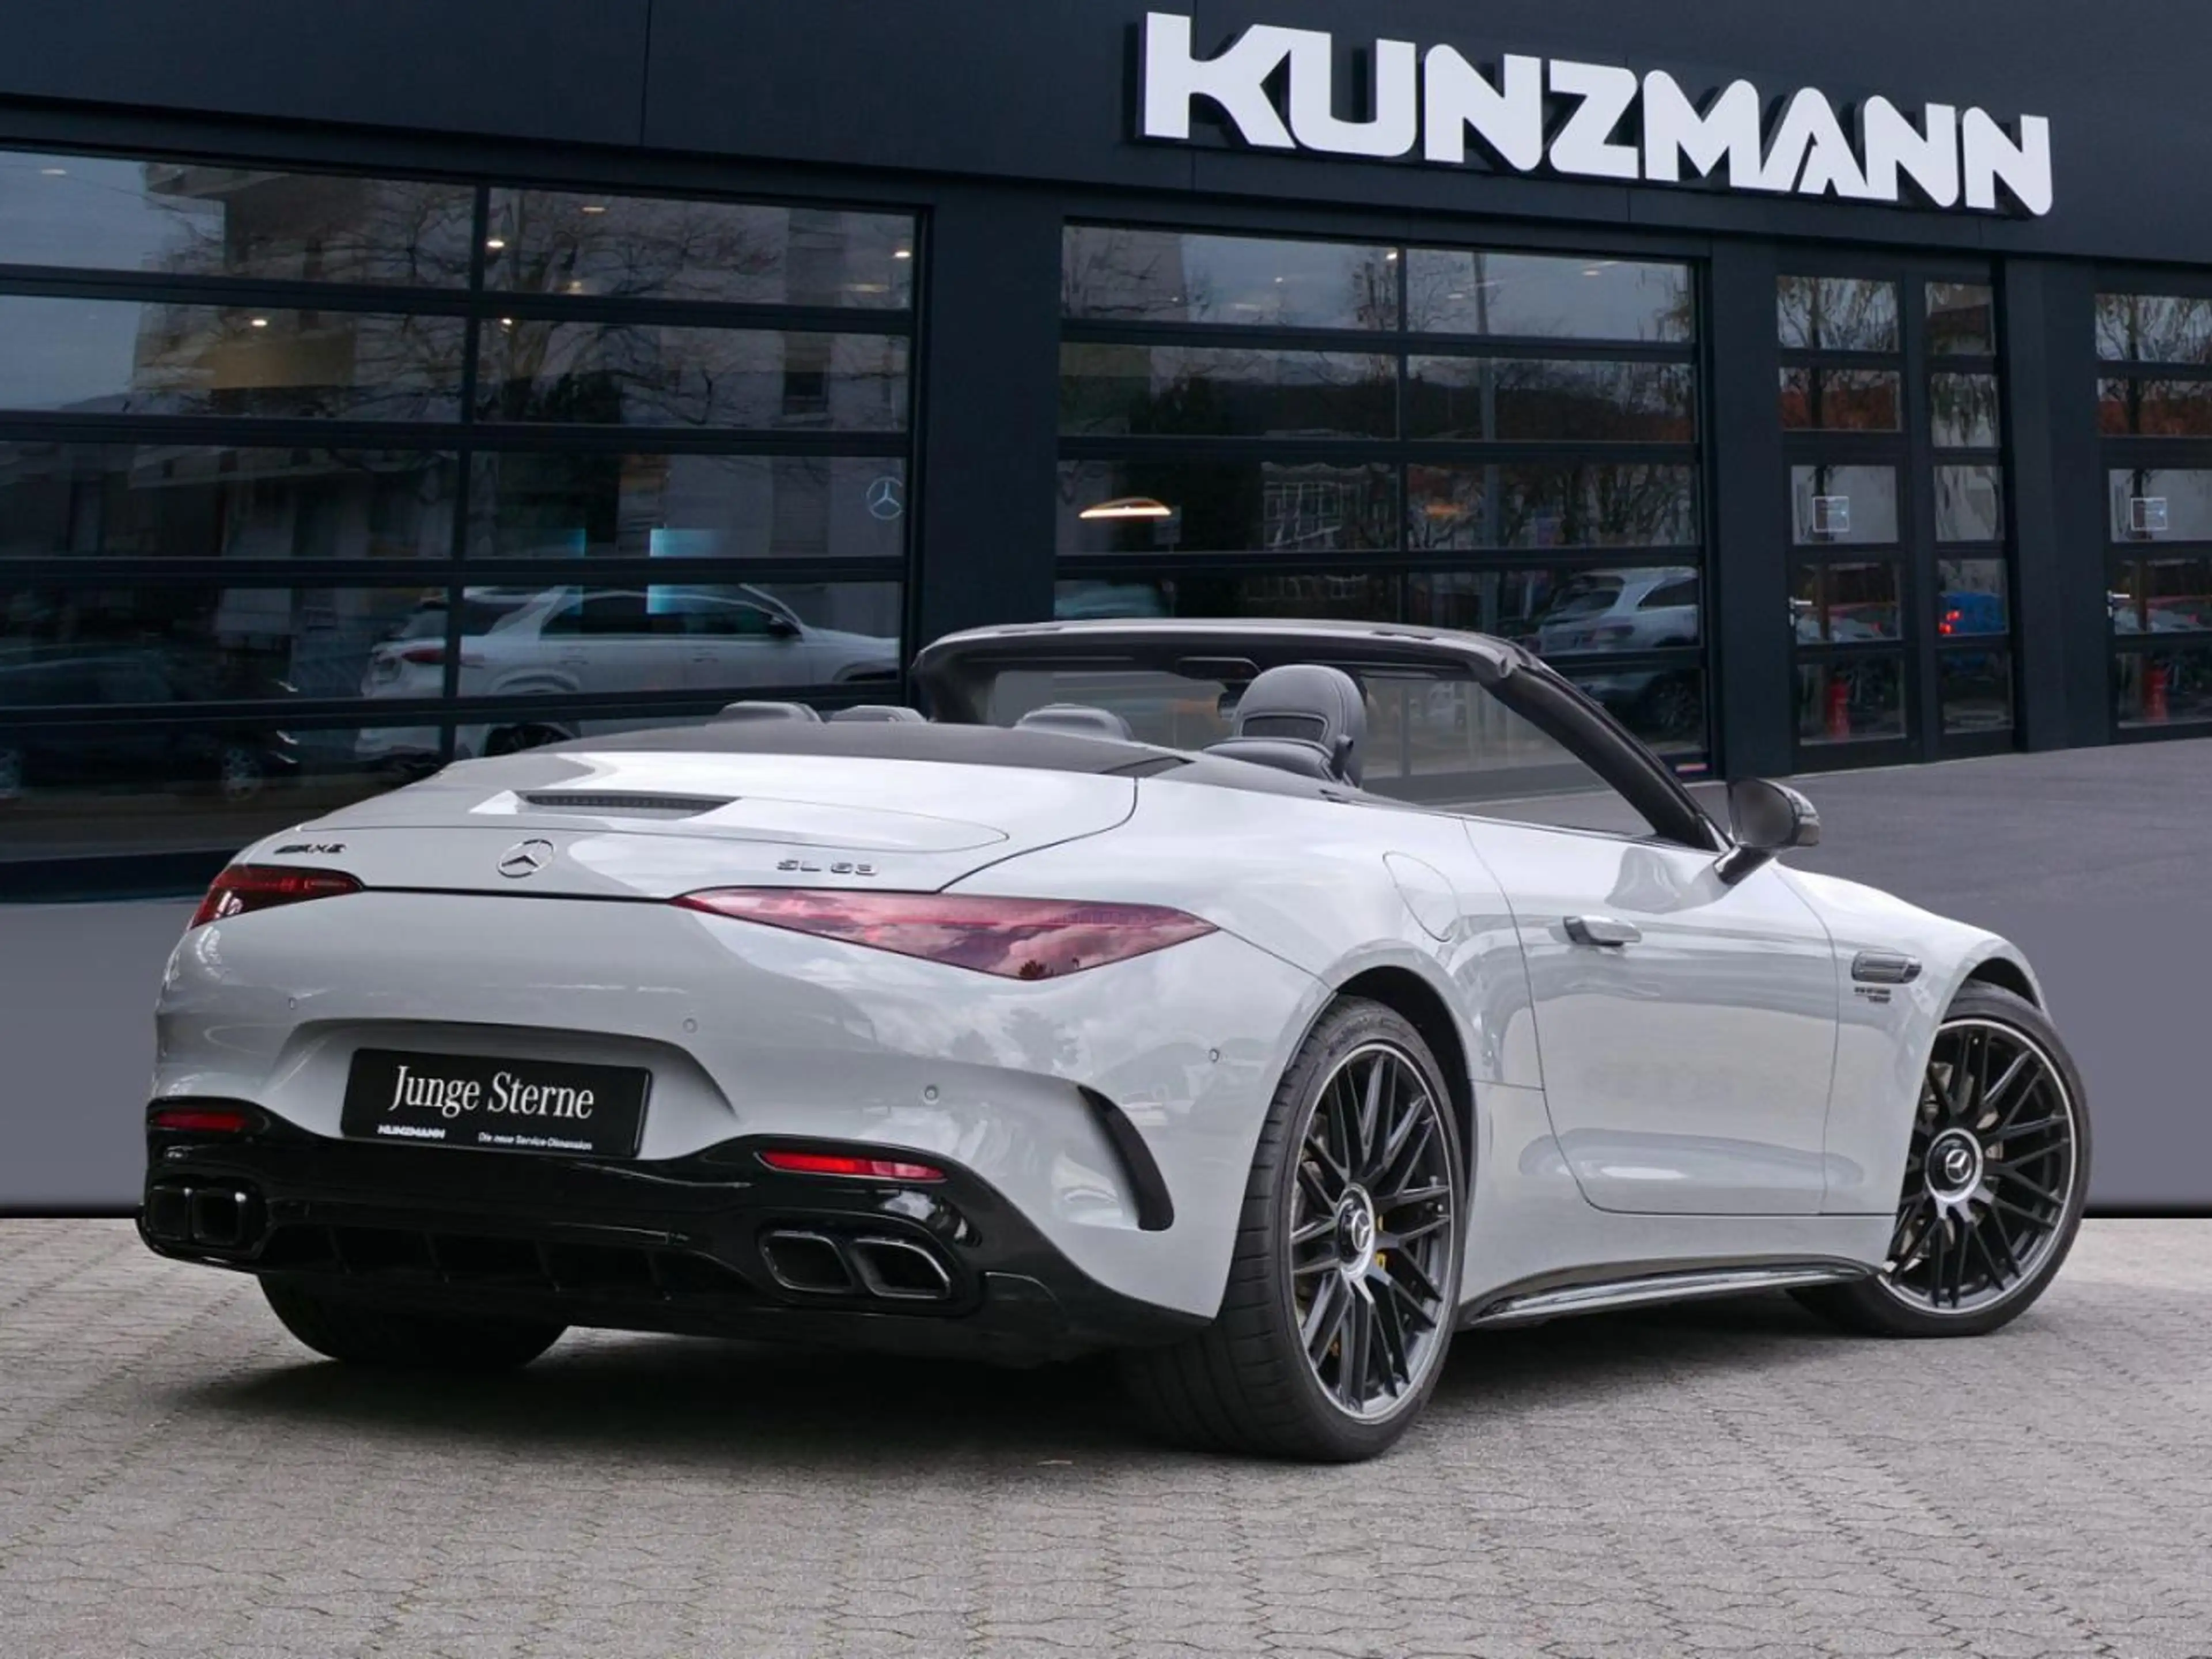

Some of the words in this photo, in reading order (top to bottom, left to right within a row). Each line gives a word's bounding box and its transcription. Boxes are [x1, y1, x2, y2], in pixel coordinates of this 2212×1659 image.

[1145, 10, 2054, 217] KUNZMANN
[388, 1065, 480, 1118] Junge
[487, 1071, 595, 1119] Sterne
